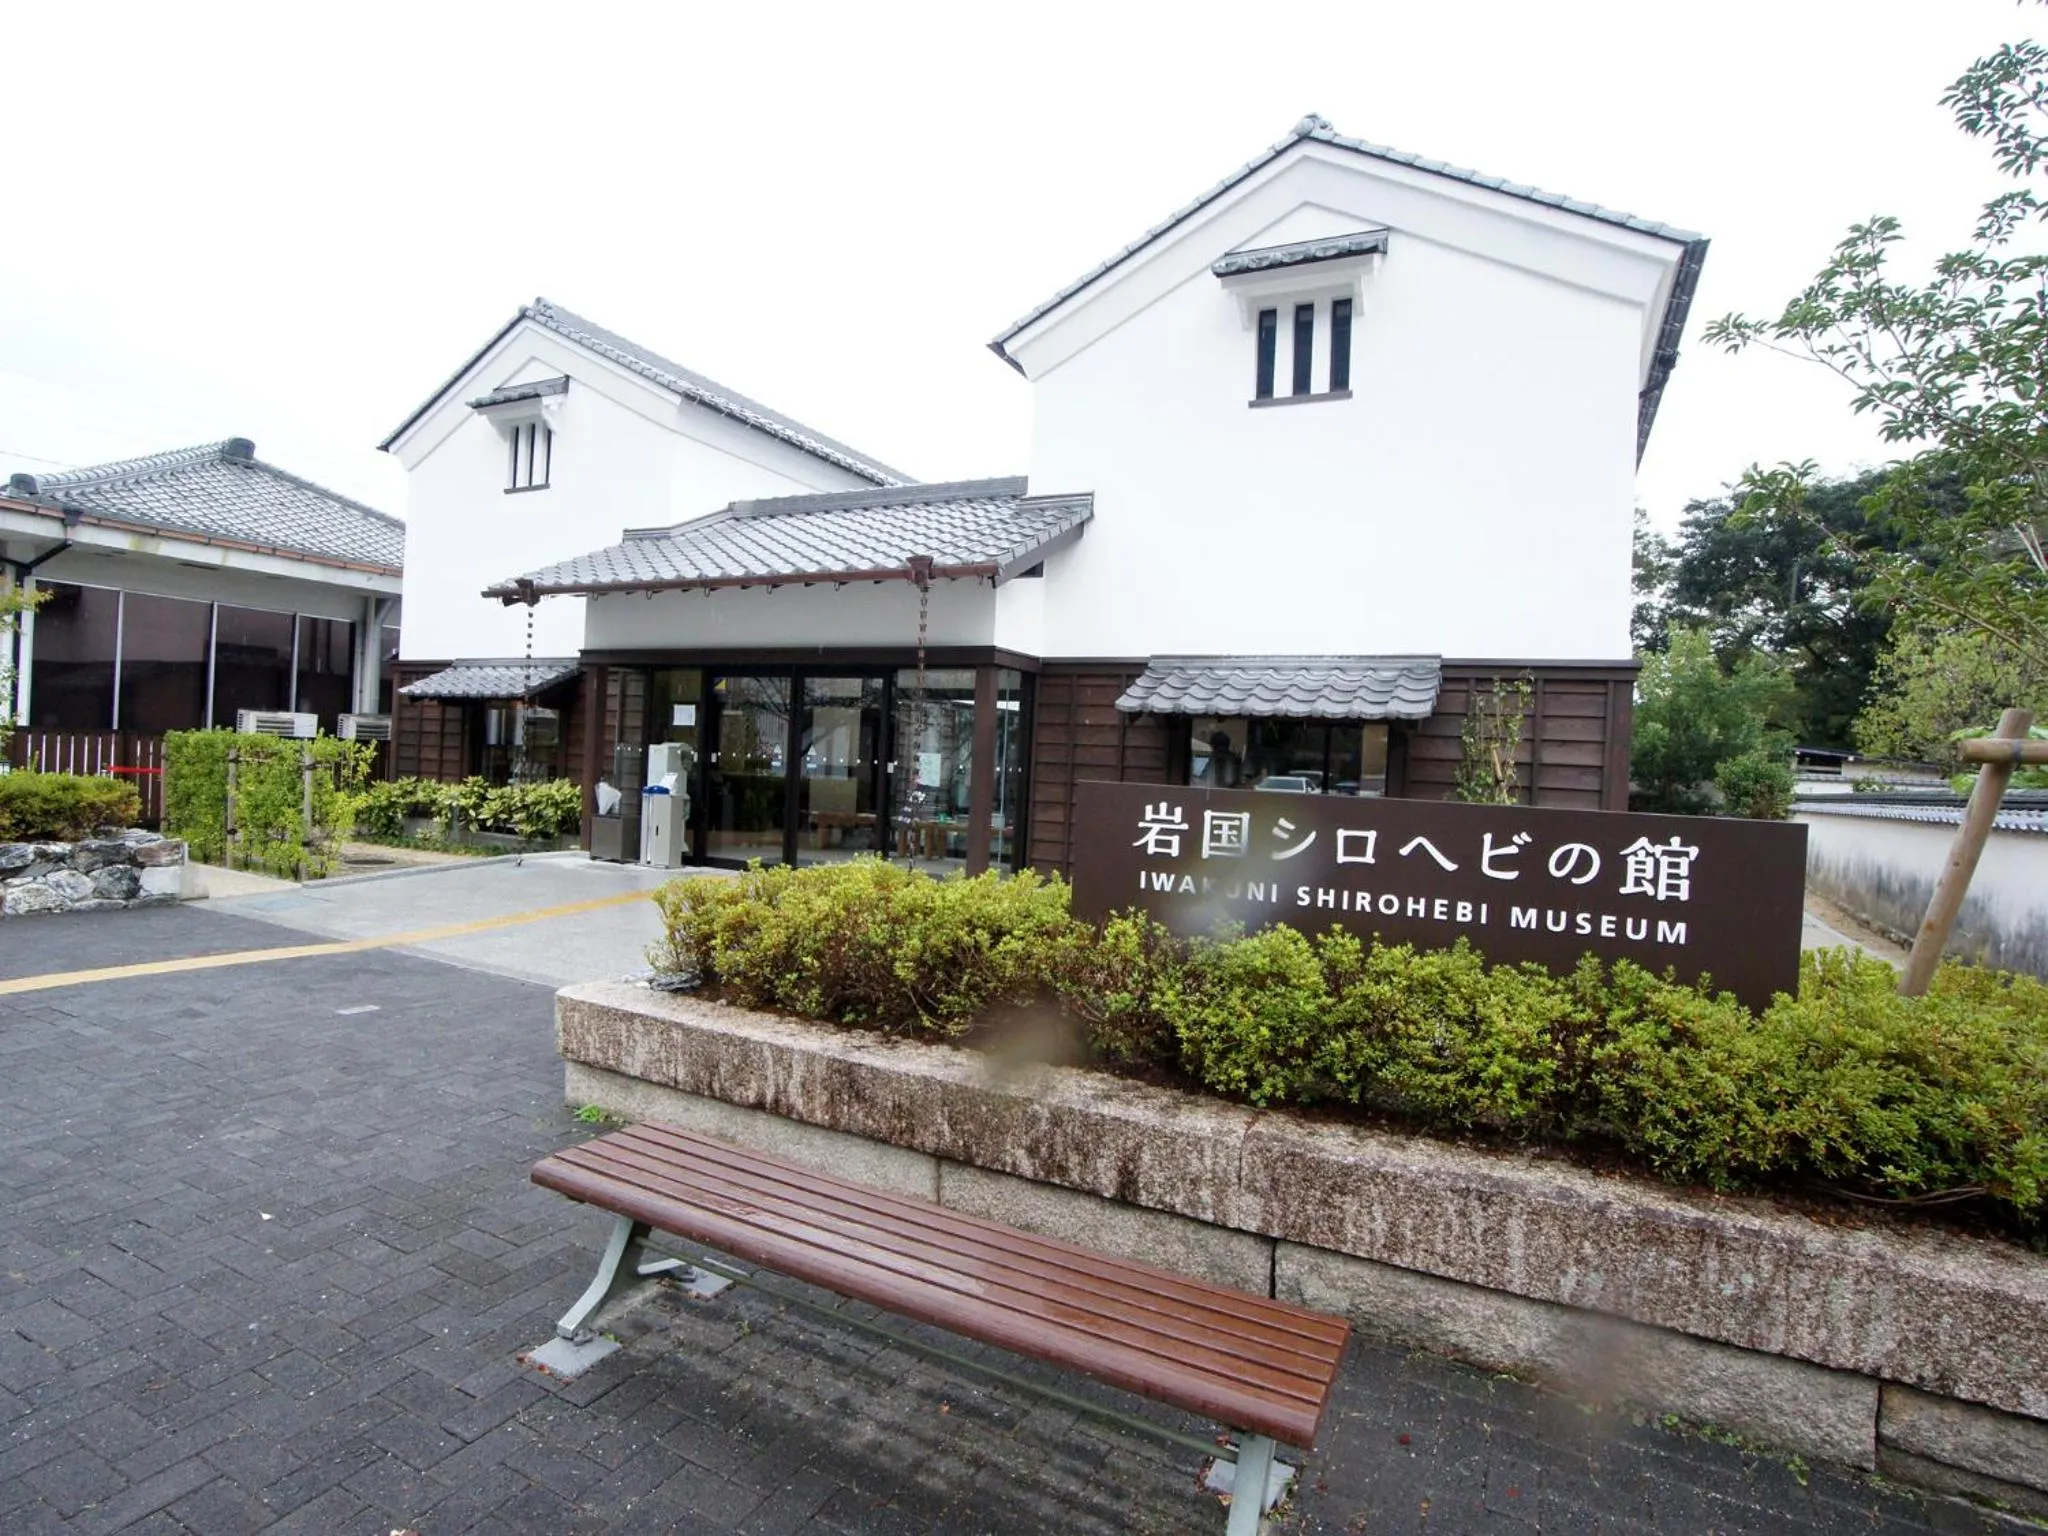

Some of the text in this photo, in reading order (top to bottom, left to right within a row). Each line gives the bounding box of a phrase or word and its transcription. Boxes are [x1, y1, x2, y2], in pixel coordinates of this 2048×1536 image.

[1132, 801, 1699, 901] 岩国シロヘビの館
[1296, 886, 1488, 924] SHIROHEBI
[1510, 906, 1687, 945] MUSEUM
